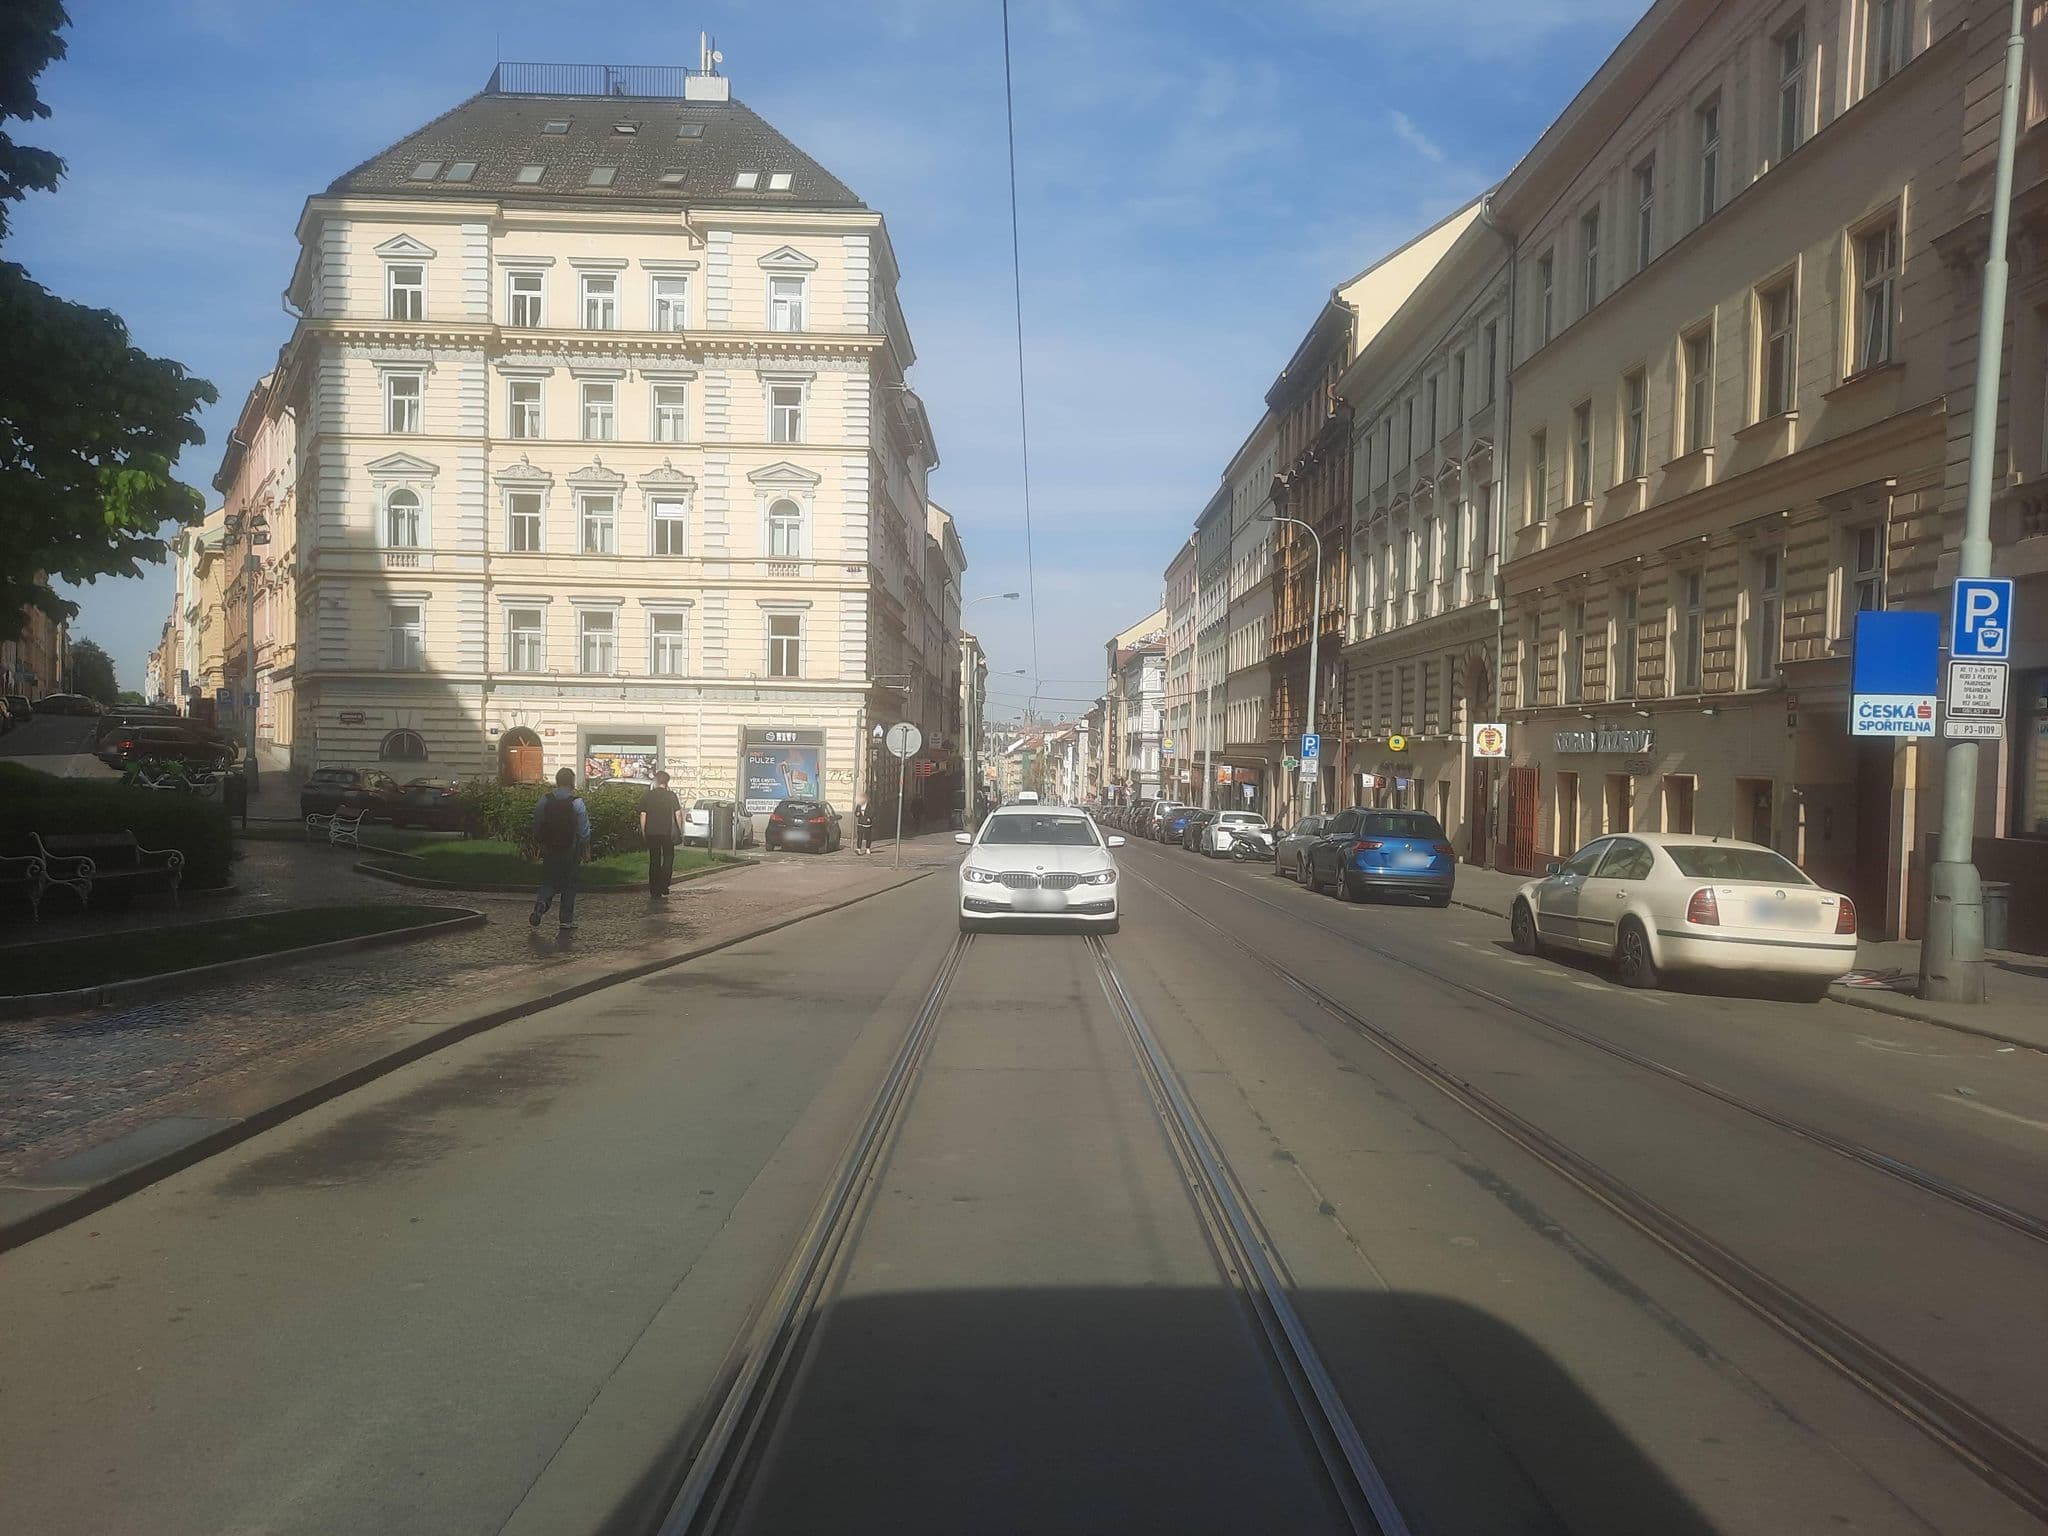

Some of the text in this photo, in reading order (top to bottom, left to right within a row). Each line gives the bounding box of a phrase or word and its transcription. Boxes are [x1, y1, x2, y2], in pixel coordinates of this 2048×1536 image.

[1965, 588, 1999, 633] P
[1859, 701, 1916, 718] ČESKÁ
[1858, 718, 1931, 732] SPOŘITELNA
[1964, 725, 1995, 734] P3-0109
[1305, 737, 1316, 751] P
[749, 756, 776, 764] PULZE
